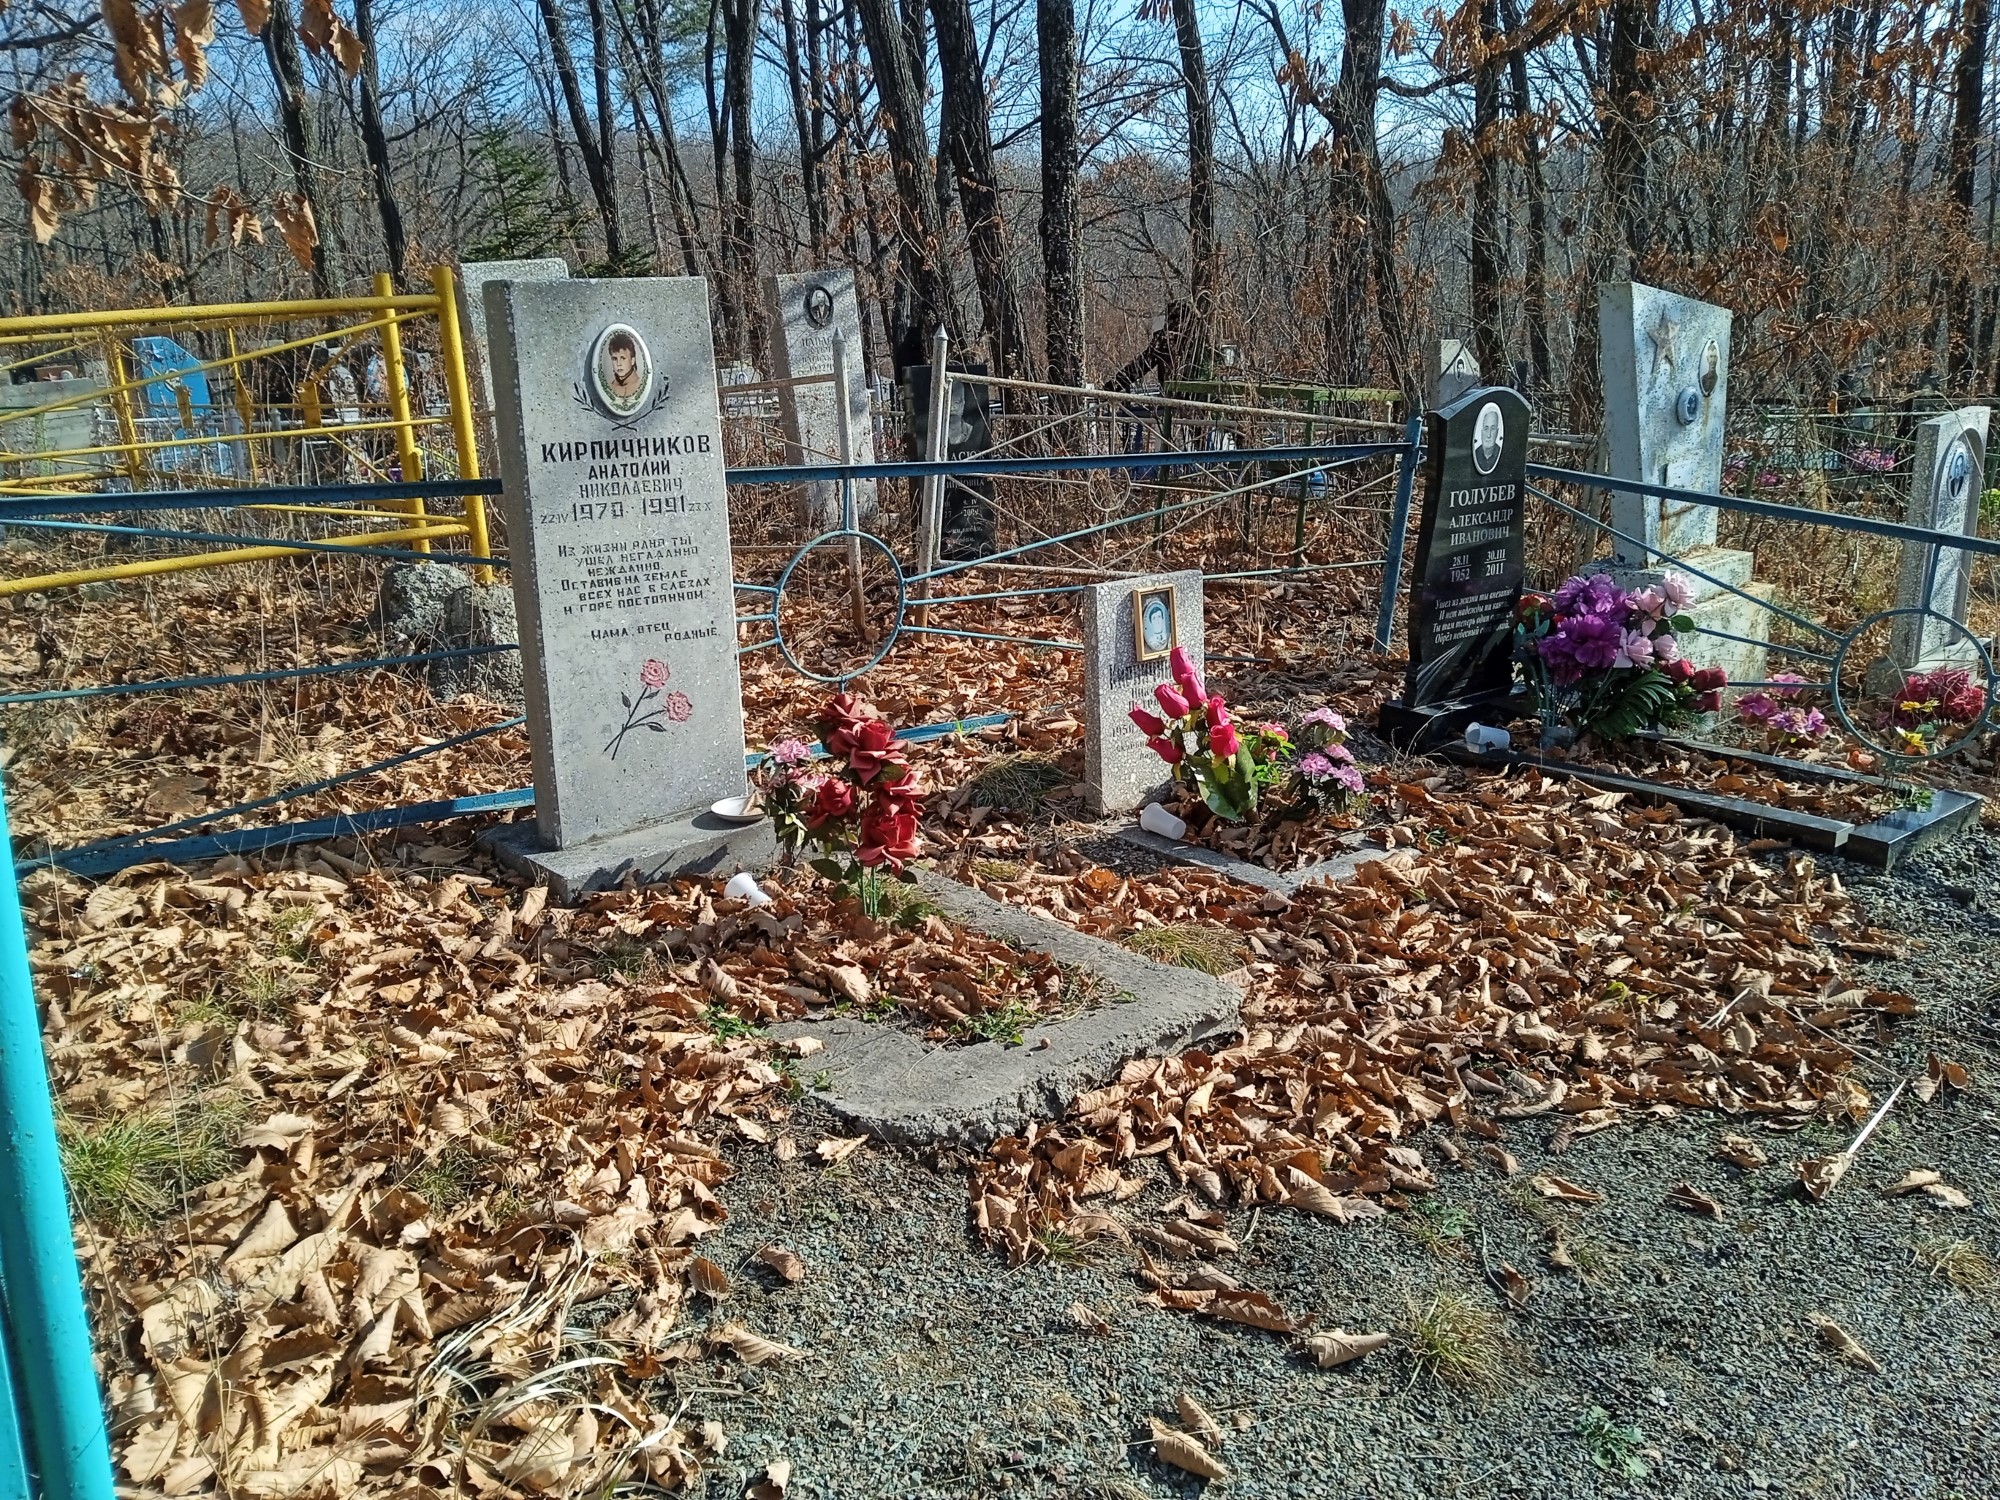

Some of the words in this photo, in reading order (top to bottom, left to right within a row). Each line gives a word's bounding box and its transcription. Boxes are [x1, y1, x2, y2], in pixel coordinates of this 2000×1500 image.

[541, 435, 710, 462] КИРПИЧНИКОВ
[588, 458, 671, 480] АНАТОЛИЙ
[579, 477, 683, 499] НИКОЛАЕВИЧ
[1449, 484, 1516, 508] ГОЛУБЕВ
[573, 501, 624, 522] 1970
[643, 495, 685, 516] 1991
[1448, 509, 1514, 529] АЛЕКСАНДР
[581, 542, 627, 555] ЖИЗНИ
[632, 538, 665, 550] РАНО
[671, 535, 692, 547] ТЫ
[1450, 526, 1510, 546] ИВАНОВИЧ
[575, 555, 613, 567] УШЕЛ
[620, 546, 698, 562] НЕГАДАННО
[624, 575, 640, 585] НА
[643, 569, 688, 582] ЗЕМЛЕ
[1451, 568, 1470, 583] 1952
[1485, 562, 1504, 576] 2011
[579, 588, 612, 602] ВСЕХ
[617, 585, 641, 597] НАС
[648, 584, 656, 593] В
[660, 577, 711, 591] СЛЕЗАХ
[580, 600, 613, 613] ГОРЕ
[618, 589, 704, 609] ПОСТОЯННОМ
[1459, 595, 1478, 605] жизни
[1433, 622, 1441, 633] Ты
[1441, 621, 1455, 631] там
[1455, 617, 1476, 629] теперь
[1438, 609, 1446, 621] И
